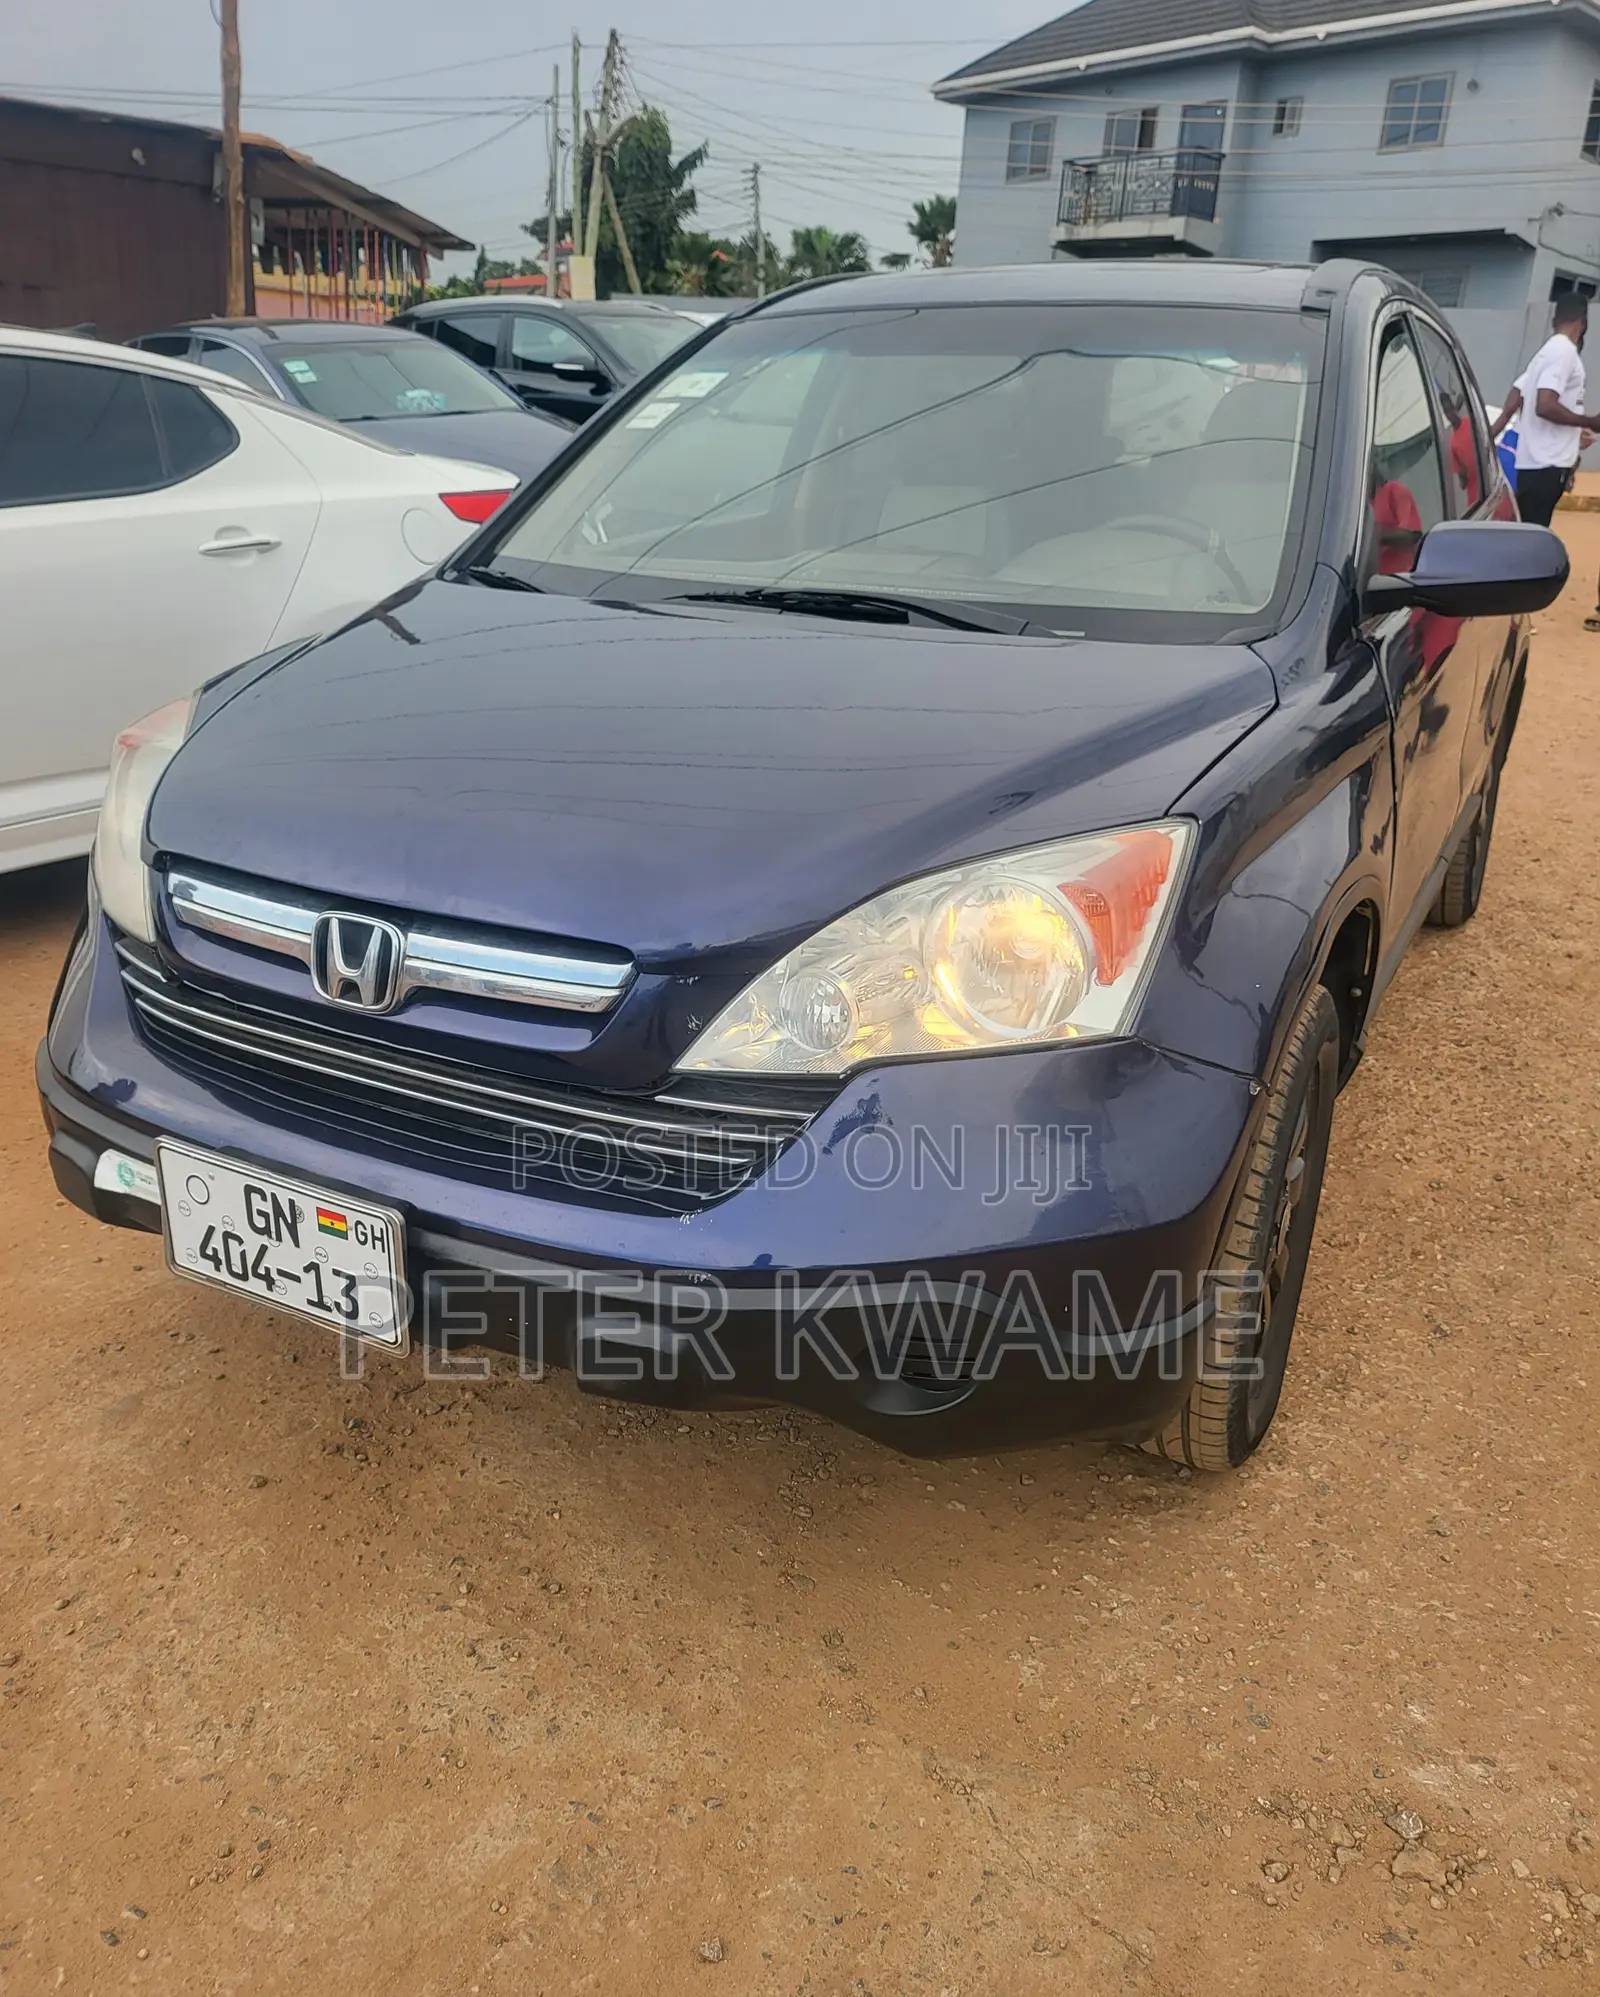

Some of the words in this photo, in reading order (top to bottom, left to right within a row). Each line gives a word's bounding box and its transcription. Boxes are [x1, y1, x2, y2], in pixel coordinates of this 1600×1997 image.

[244, 1183, 300, 1249] GN
[354, 1219, 386, 1253] GH
[199, 1224, 359, 1320] 404-13
